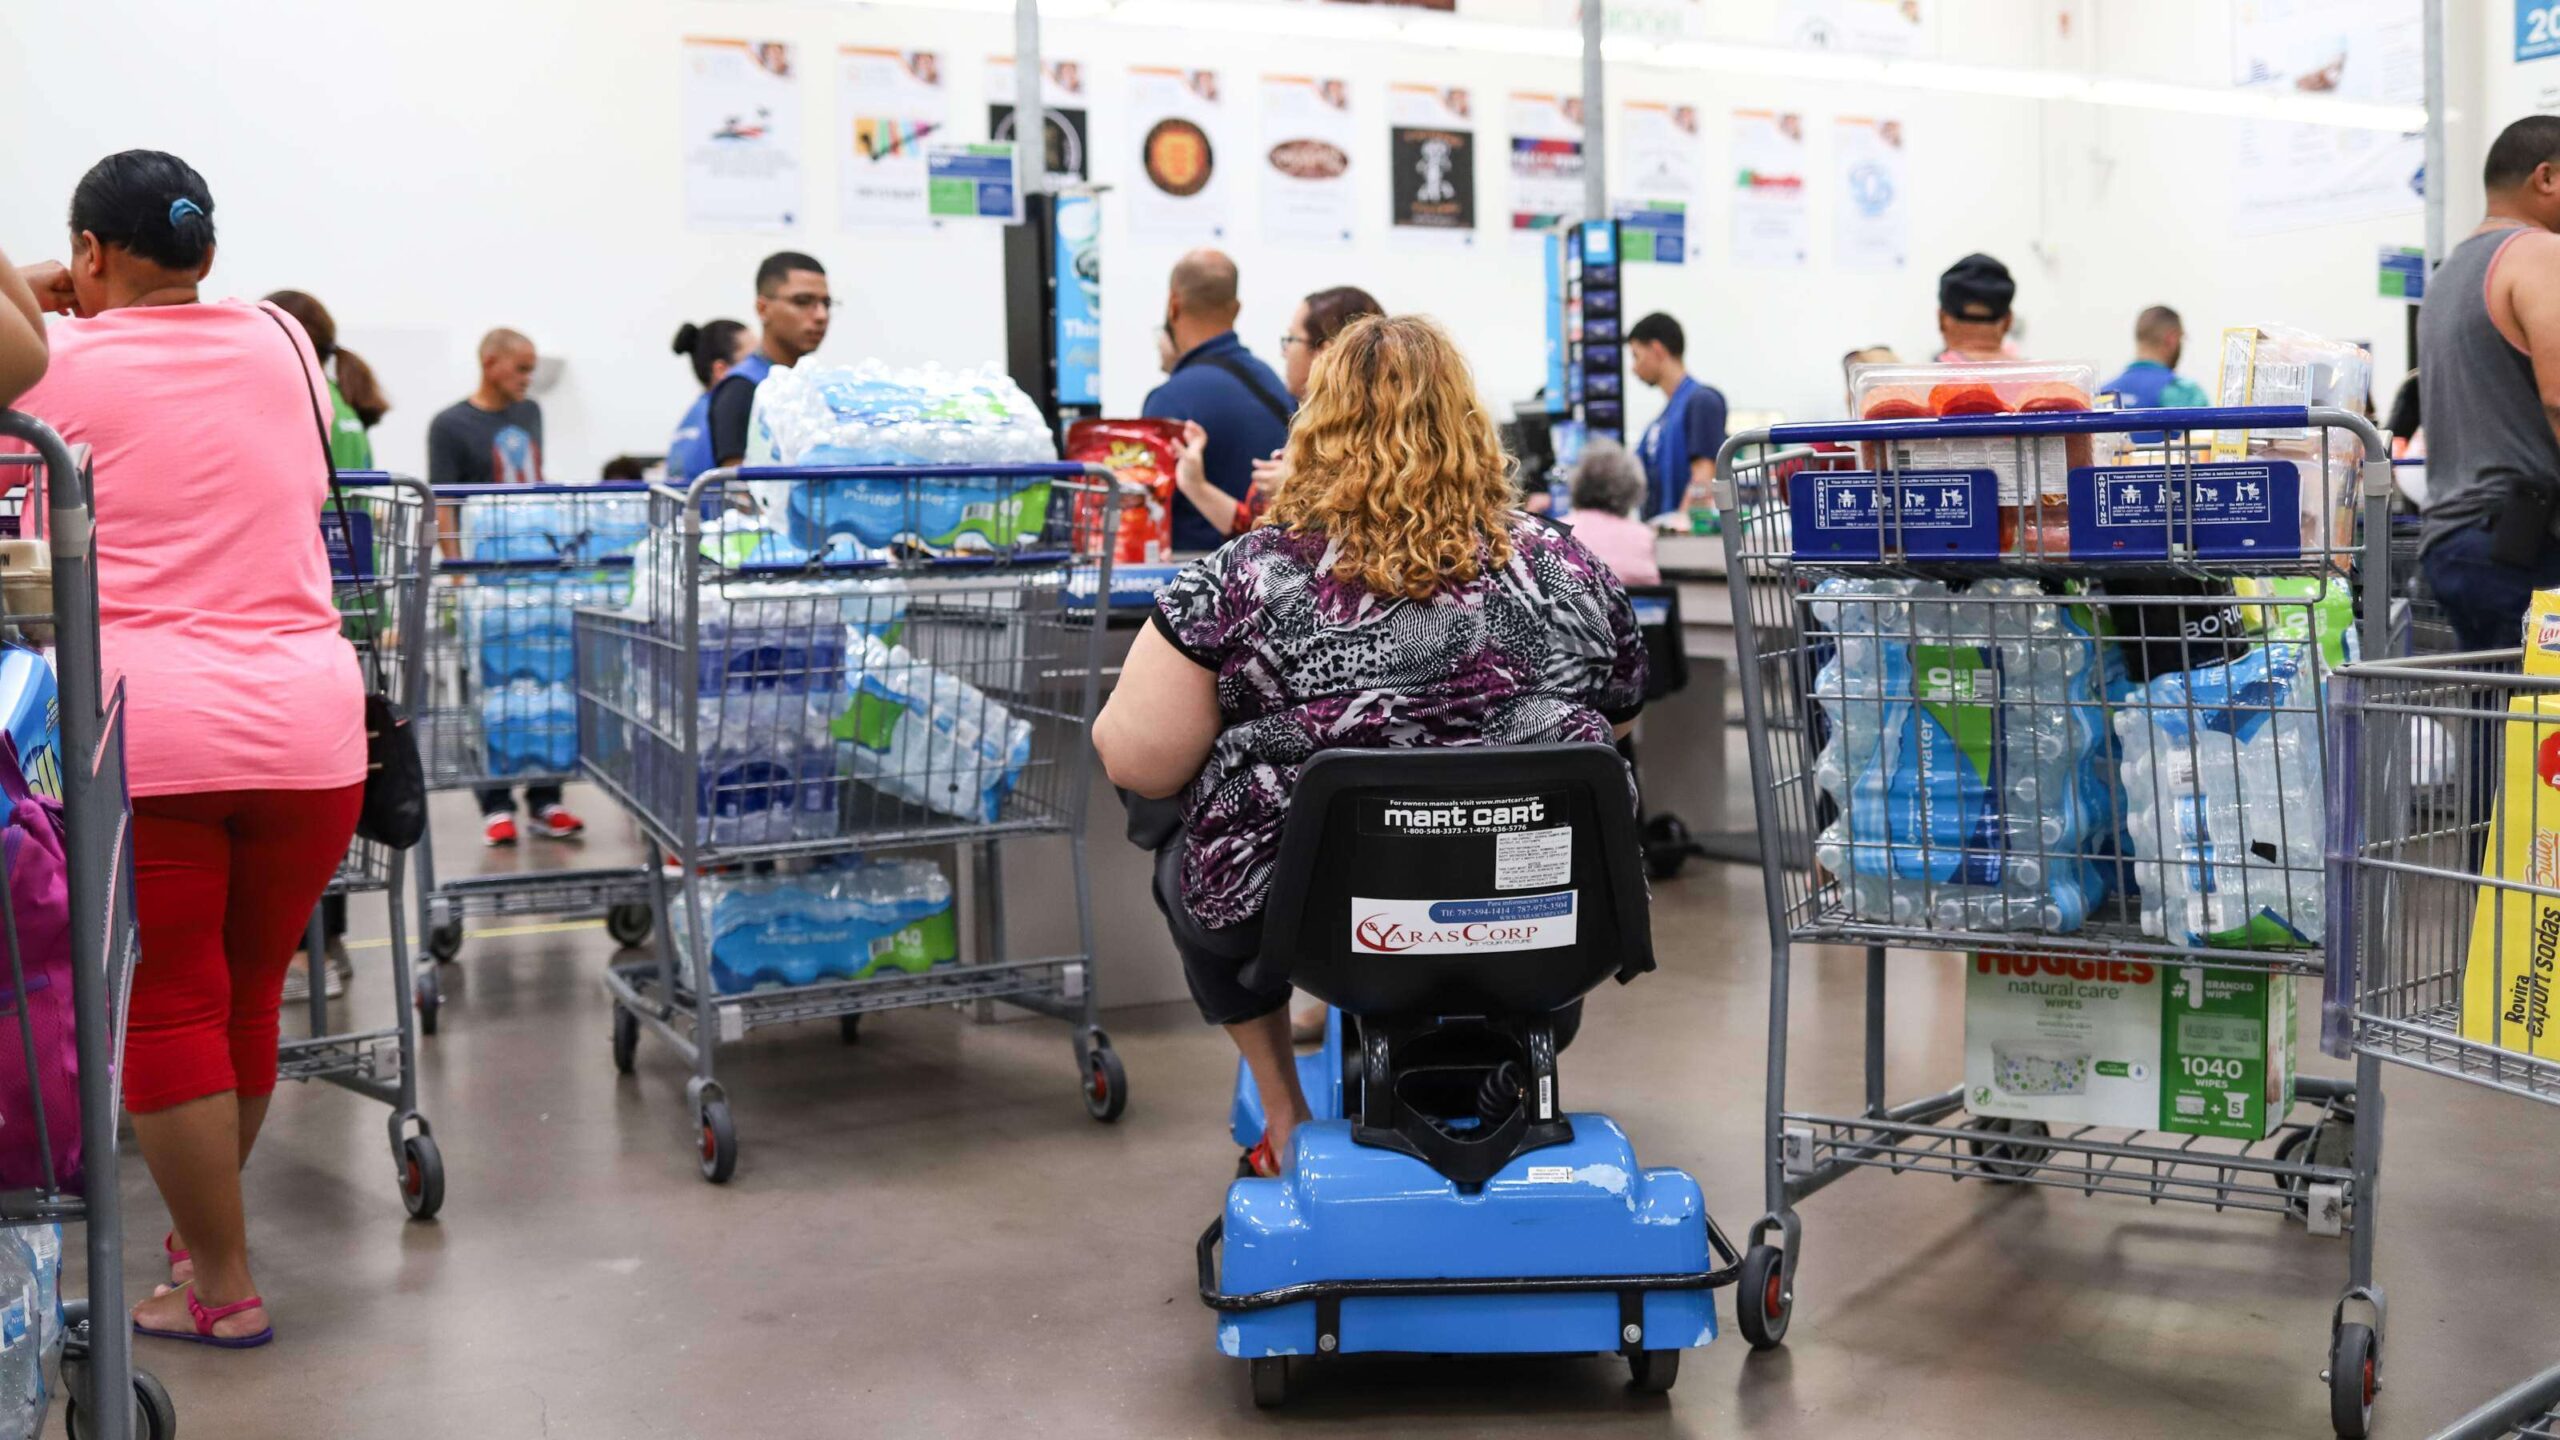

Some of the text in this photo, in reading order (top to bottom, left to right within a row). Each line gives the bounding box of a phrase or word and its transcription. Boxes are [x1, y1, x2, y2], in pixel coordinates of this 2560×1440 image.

[1816, 480, 1827, 528] WARNING
[2097, 474, 2108, 525] WARNING
[1384, 801, 1544, 827] mart cart
[2533, 906, 2560, 972] sodas
[2007, 980, 2120, 1000] natural care
[2204, 980, 2255, 992] BRANDED
[2044, 998, 2083, 1010] WIPES
[2504, 974, 2531, 1024] Rovira
[2181, 1056, 2244, 1079] 1040
[2194, 1078, 2229, 1089] WIPES
[2231, 1102, 2241, 1115] 5
